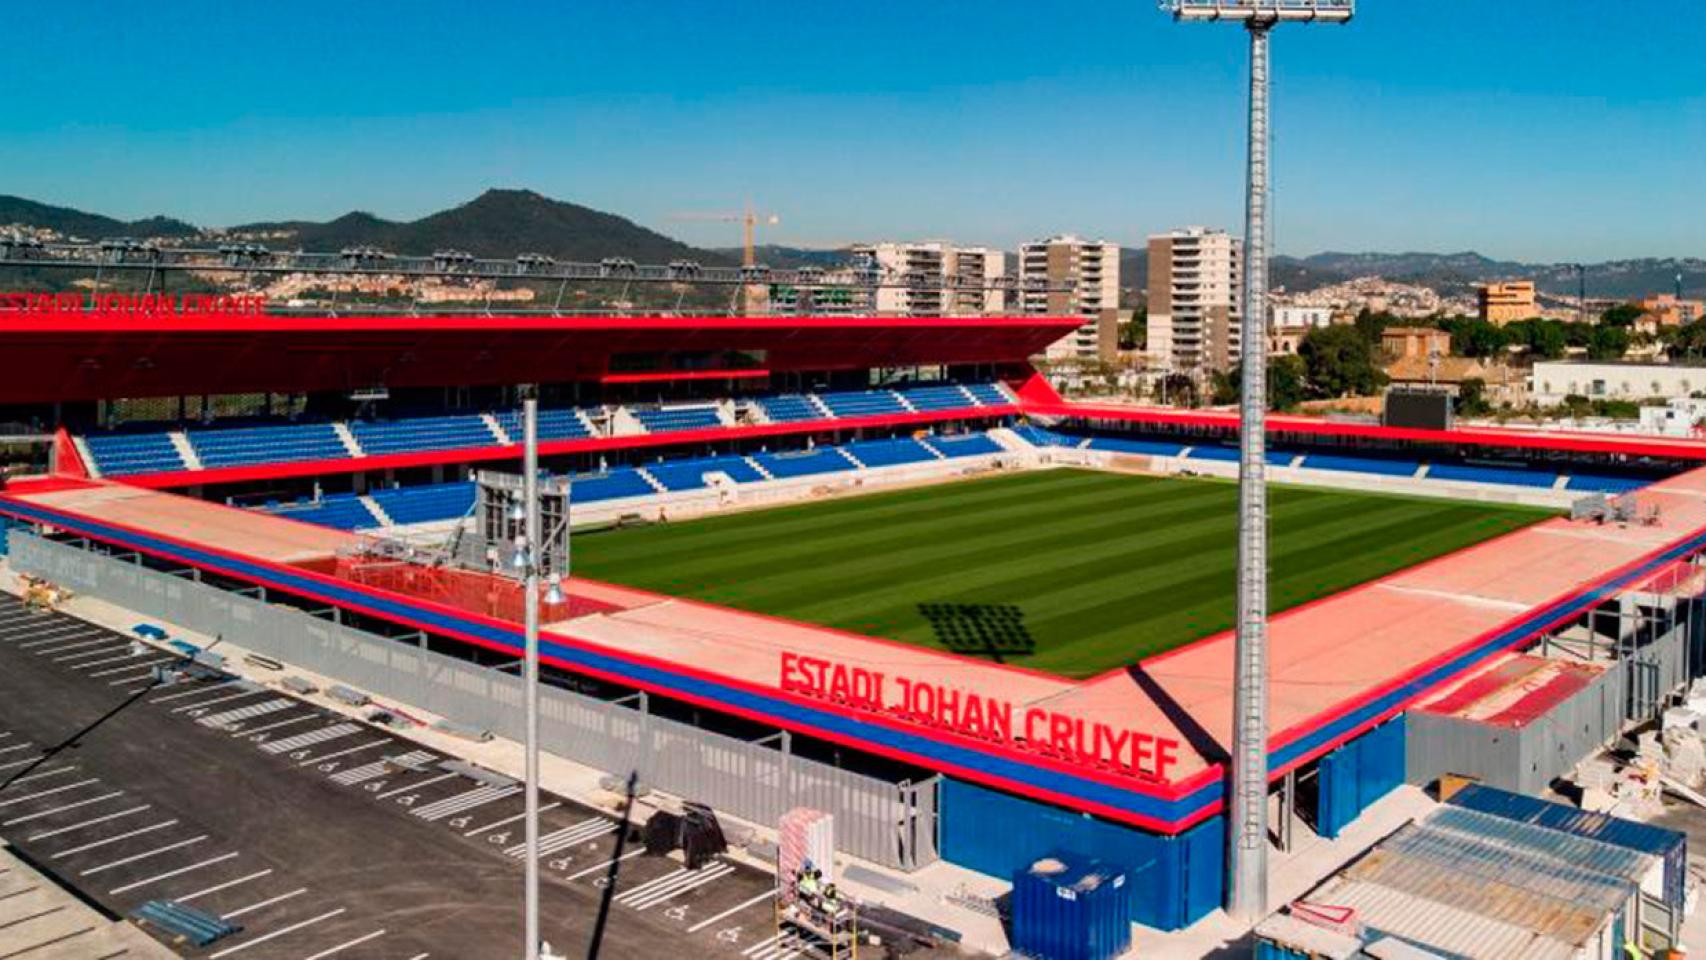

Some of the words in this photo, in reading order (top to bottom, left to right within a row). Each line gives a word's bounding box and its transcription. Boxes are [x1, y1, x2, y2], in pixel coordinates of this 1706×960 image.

[93, 292, 176, 315] JOHAN
[781, 652, 884, 702] ESTADI
[896, 677, 1011, 742] JOHAN
[1025, 708, 1178, 780] CRUYFF
